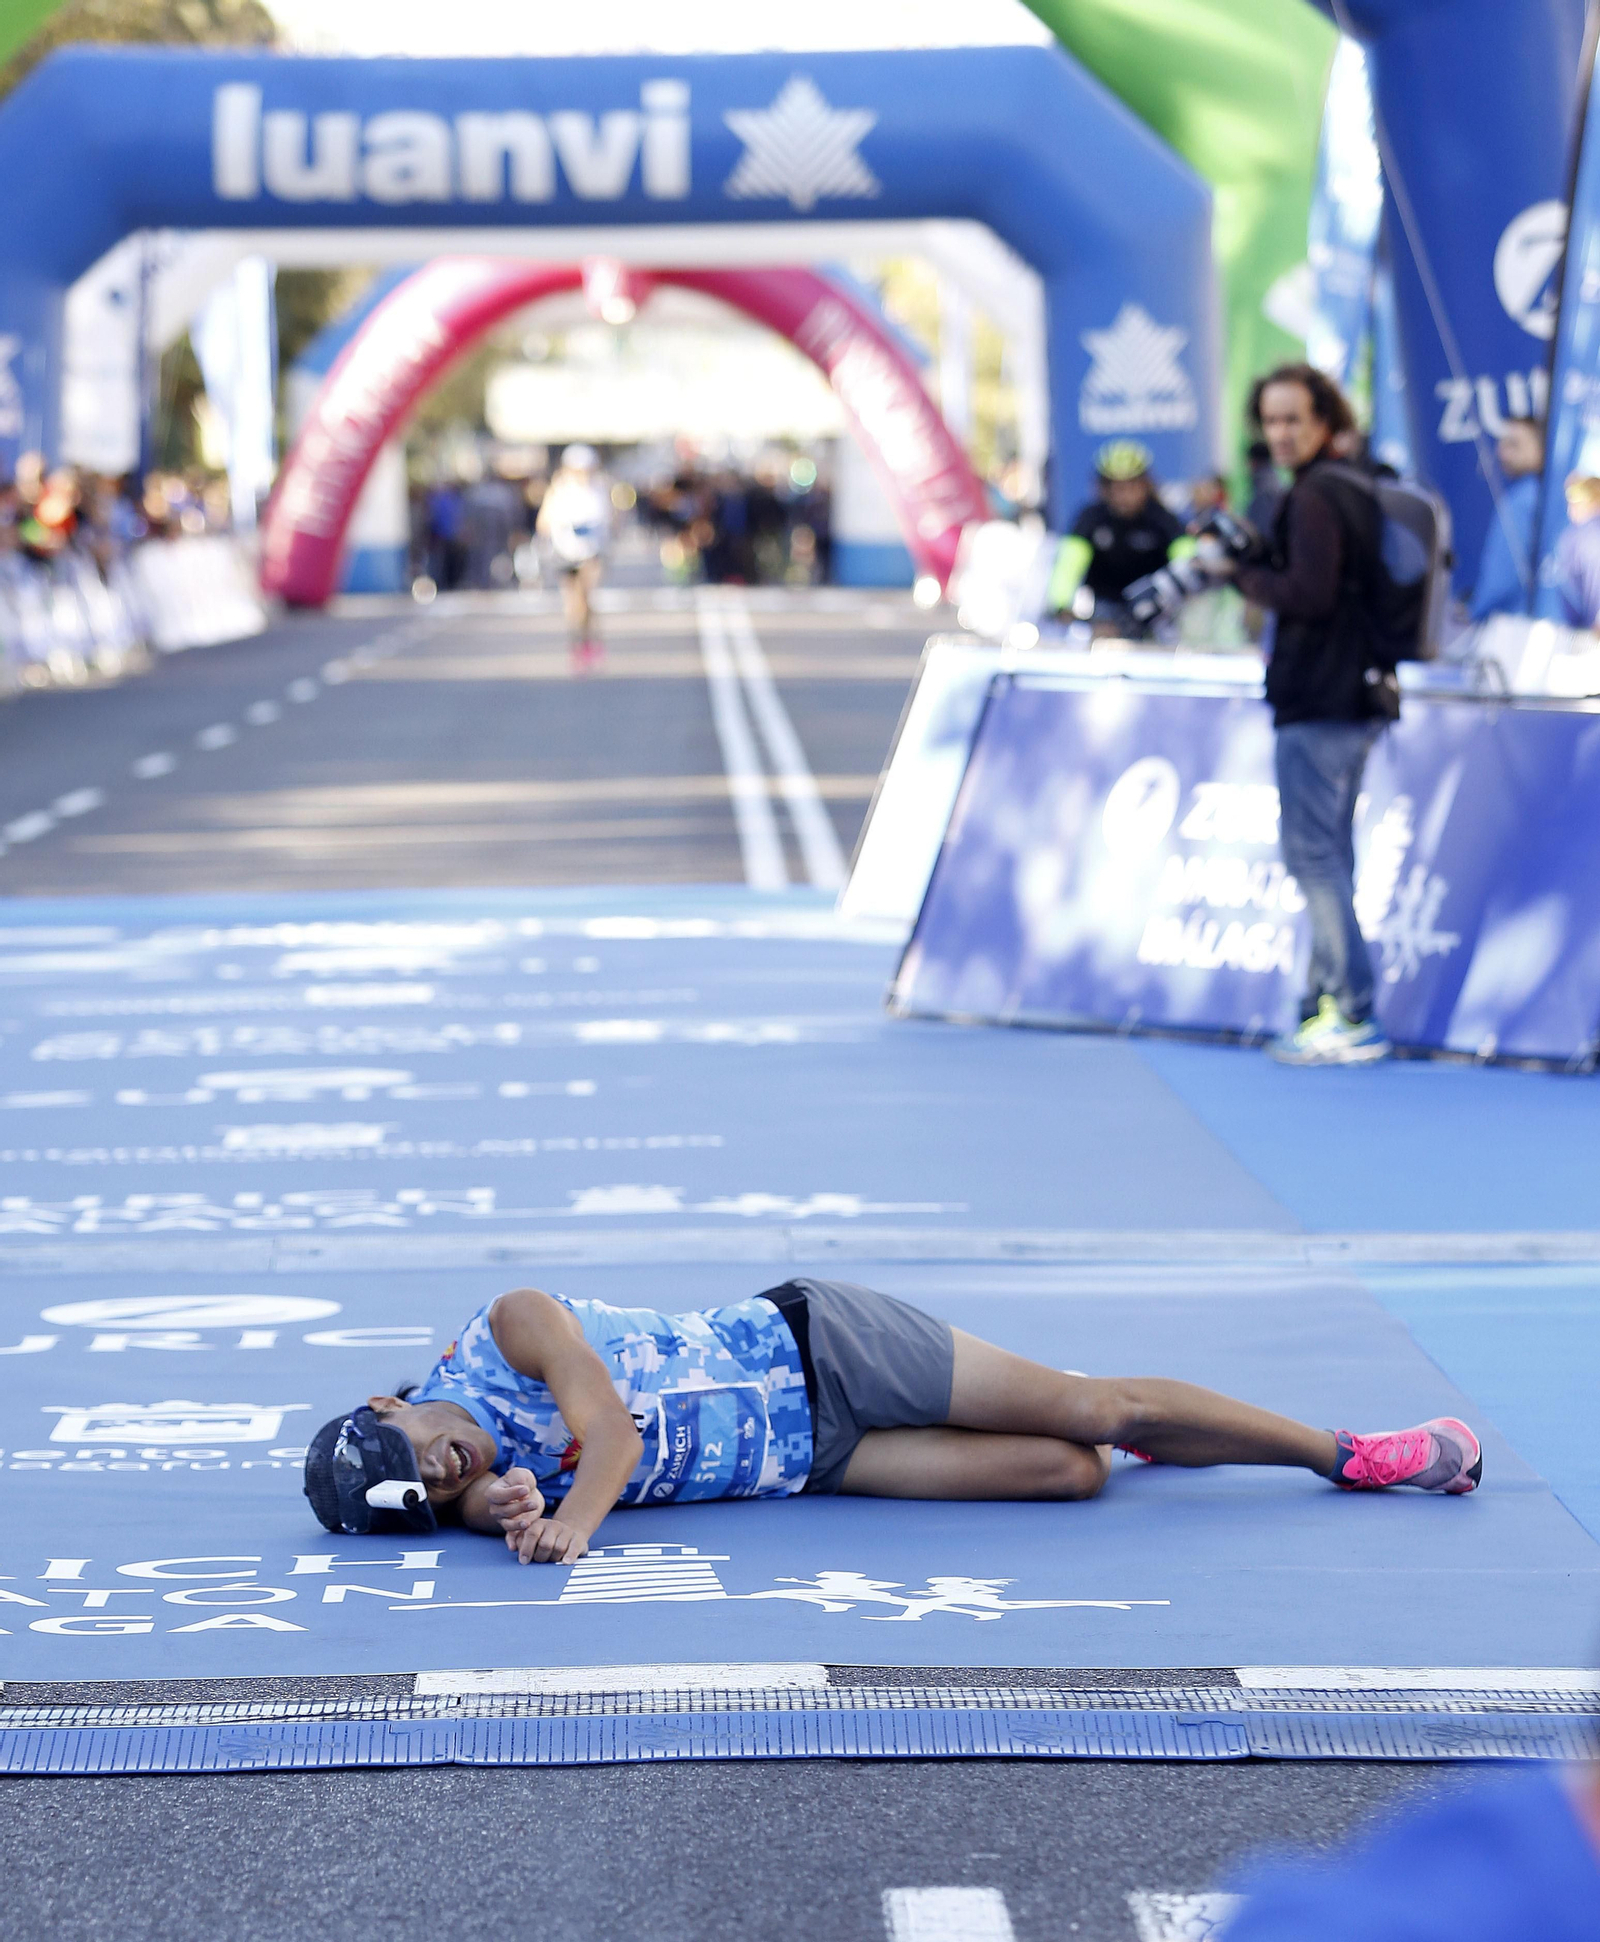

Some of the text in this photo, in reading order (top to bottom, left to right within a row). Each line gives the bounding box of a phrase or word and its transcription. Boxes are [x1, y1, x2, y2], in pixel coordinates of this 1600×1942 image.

[213, 81, 691, 200] luanvi
[0, 1448, 229, 1460] ento
[695, 1441, 723, 1484] 512
[0, 1550, 446, 1580] ICH
[0, 1613, 310, 1636] GA
